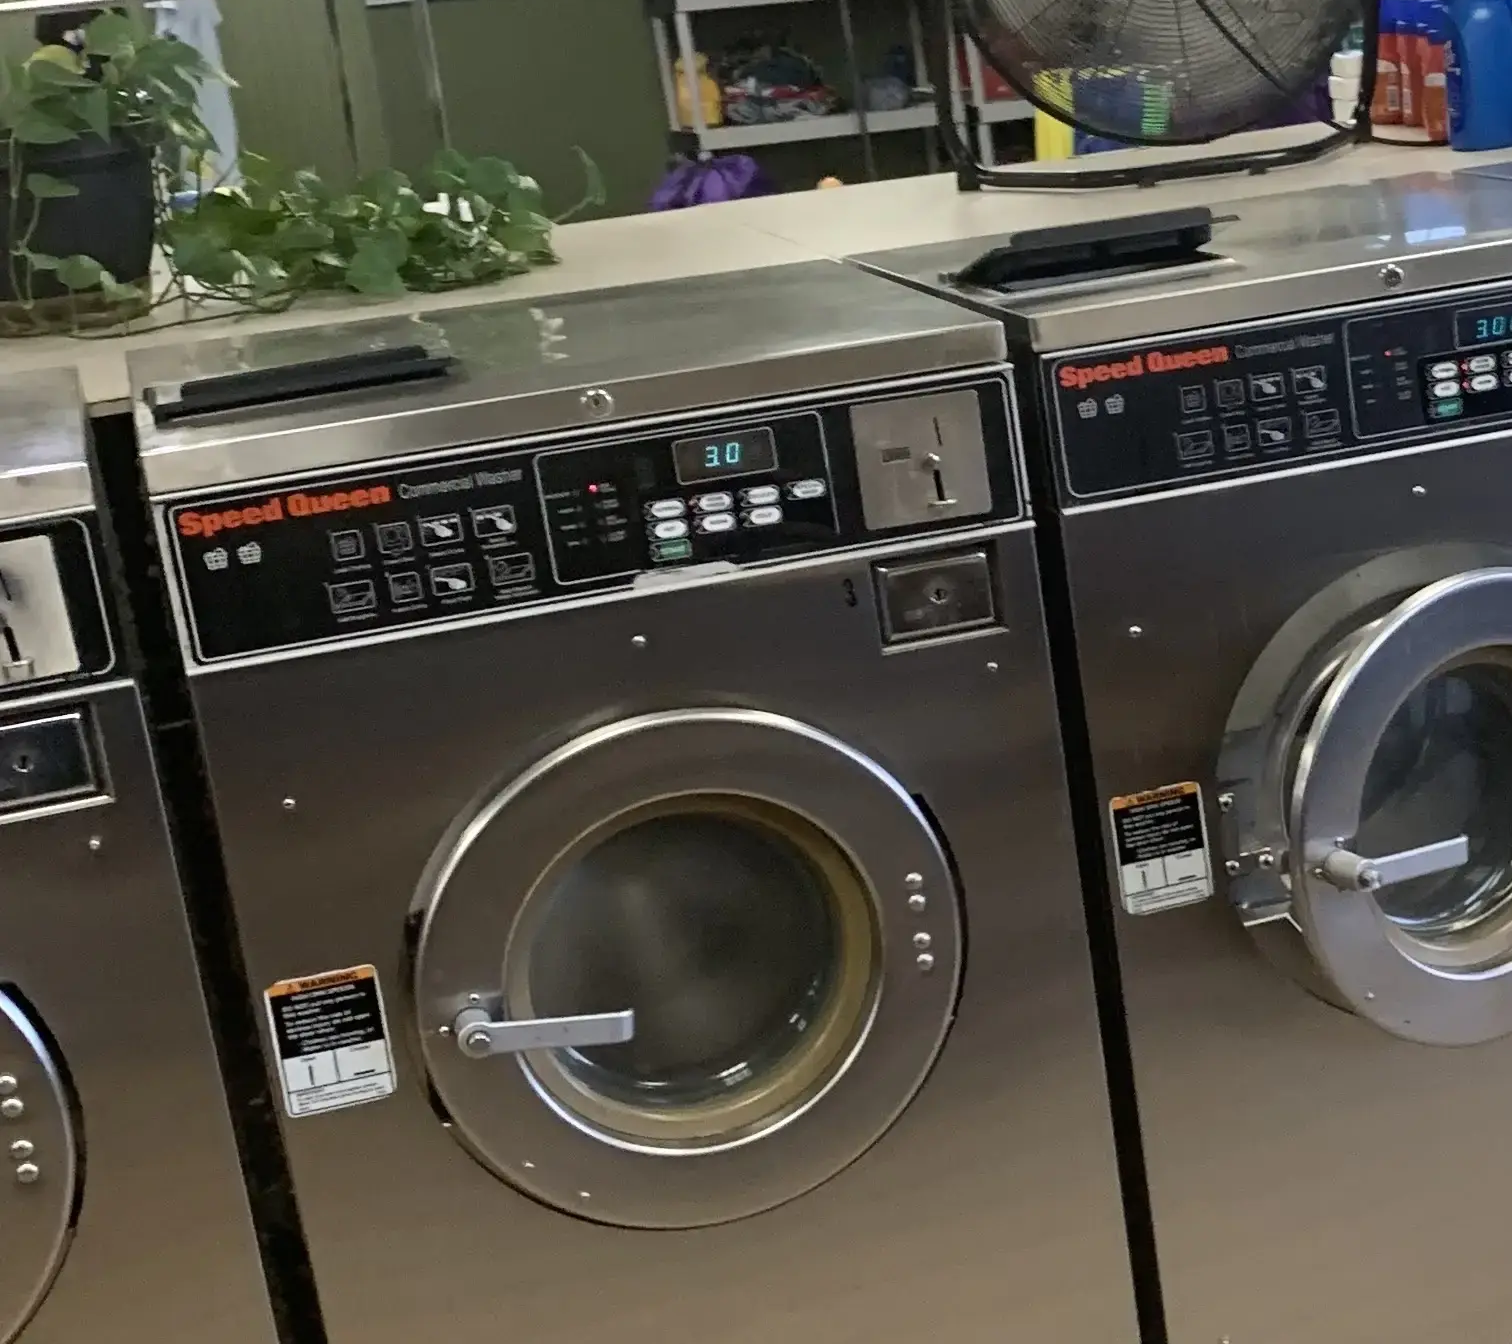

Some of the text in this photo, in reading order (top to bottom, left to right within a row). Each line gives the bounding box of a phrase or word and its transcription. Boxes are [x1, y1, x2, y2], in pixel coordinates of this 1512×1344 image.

[1059, 354, 1143, 390] Speed
[1146, 344, 1232, 373] Queen
[178, 496, 284, 538] Speed
[287, 483, 393, 518] Queen
